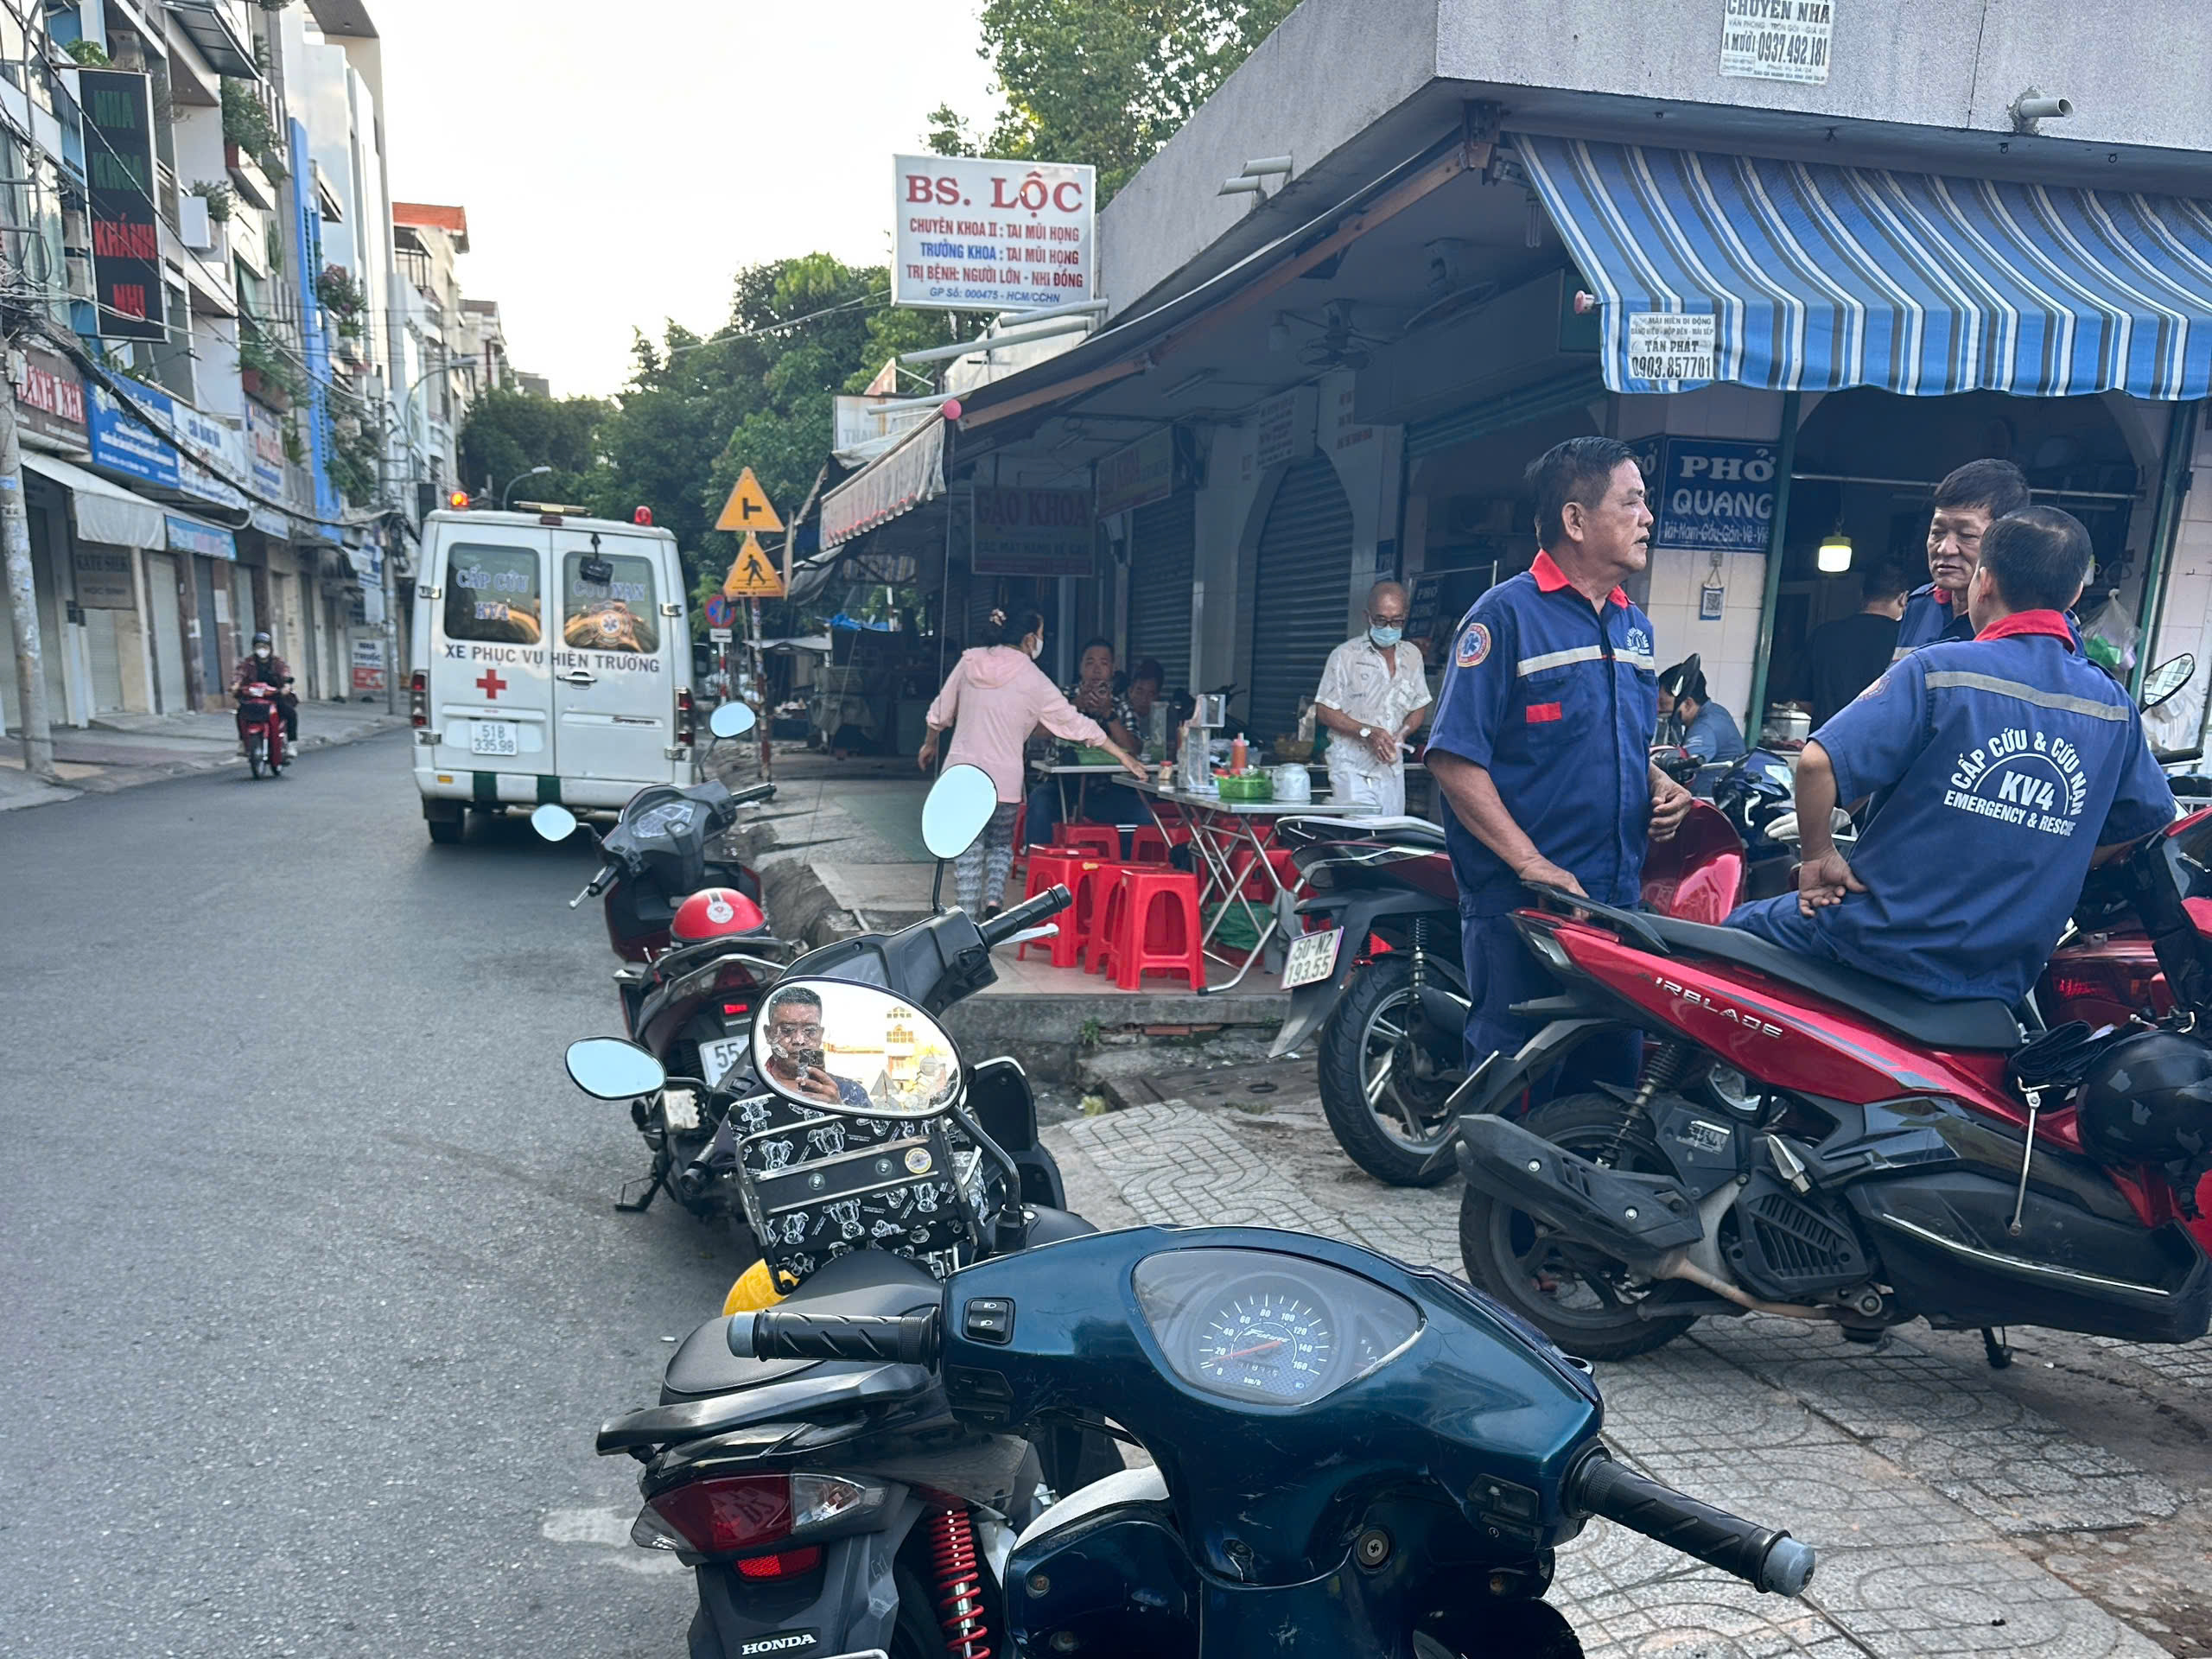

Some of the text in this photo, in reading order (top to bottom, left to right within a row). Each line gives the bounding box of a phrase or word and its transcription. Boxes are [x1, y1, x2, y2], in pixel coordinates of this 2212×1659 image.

[906, 170, 1083, 218] BS. LỘC
[93, 212, 156, 259] KHÁNH
[910, 218, 953, 234] CHUYÊN
[957, 221, 986, 237] KHOA
[1007, 225, 1021, 238] TAI
[1050, 226, 1079, 245] HỌNG
[968, 245, 996, 261] KHOA
[1007, 247, 1021, 262] TAI
[1050, 250, 1079, 268] HỌNG
[1032, 271, 1050, 286] NHI
[930, 287, 944, 297] GP
[965, 289, 998, 300] 000475
[1631, 356, 1711, 378] 0903.857701
[1679, 448, 1776, 482] PHỞ
[456, 563, 491, 588] CẤP
[445, 644, 659, 672] XE PHỤC VỤ HIỆN TRƯỜNG
[1951, 728, 2087, 816] CẤP CỨU & CỨU NẠN
[1998, 770, 2056, 811] KV4
[1944, 790, 2026, 825] EMERGENCY
[2027, 812, 2037, 829] &
[1240, 1315, 1251, 1325] 60
[1260, 1308, 1271, 1318] 80
[1281, 1313, 1295, 1322] 100
[1224, 1328, 1234, 1337] 40
[1294, 1326, 1307, 1336] 120
[1215, 1347, 1226, 1356] 20
[1299, 1344, 1313, 1352] 140
[1293, 1361, 1307, 1370] 160
[741, 1633, 817, 1656] HONDA
